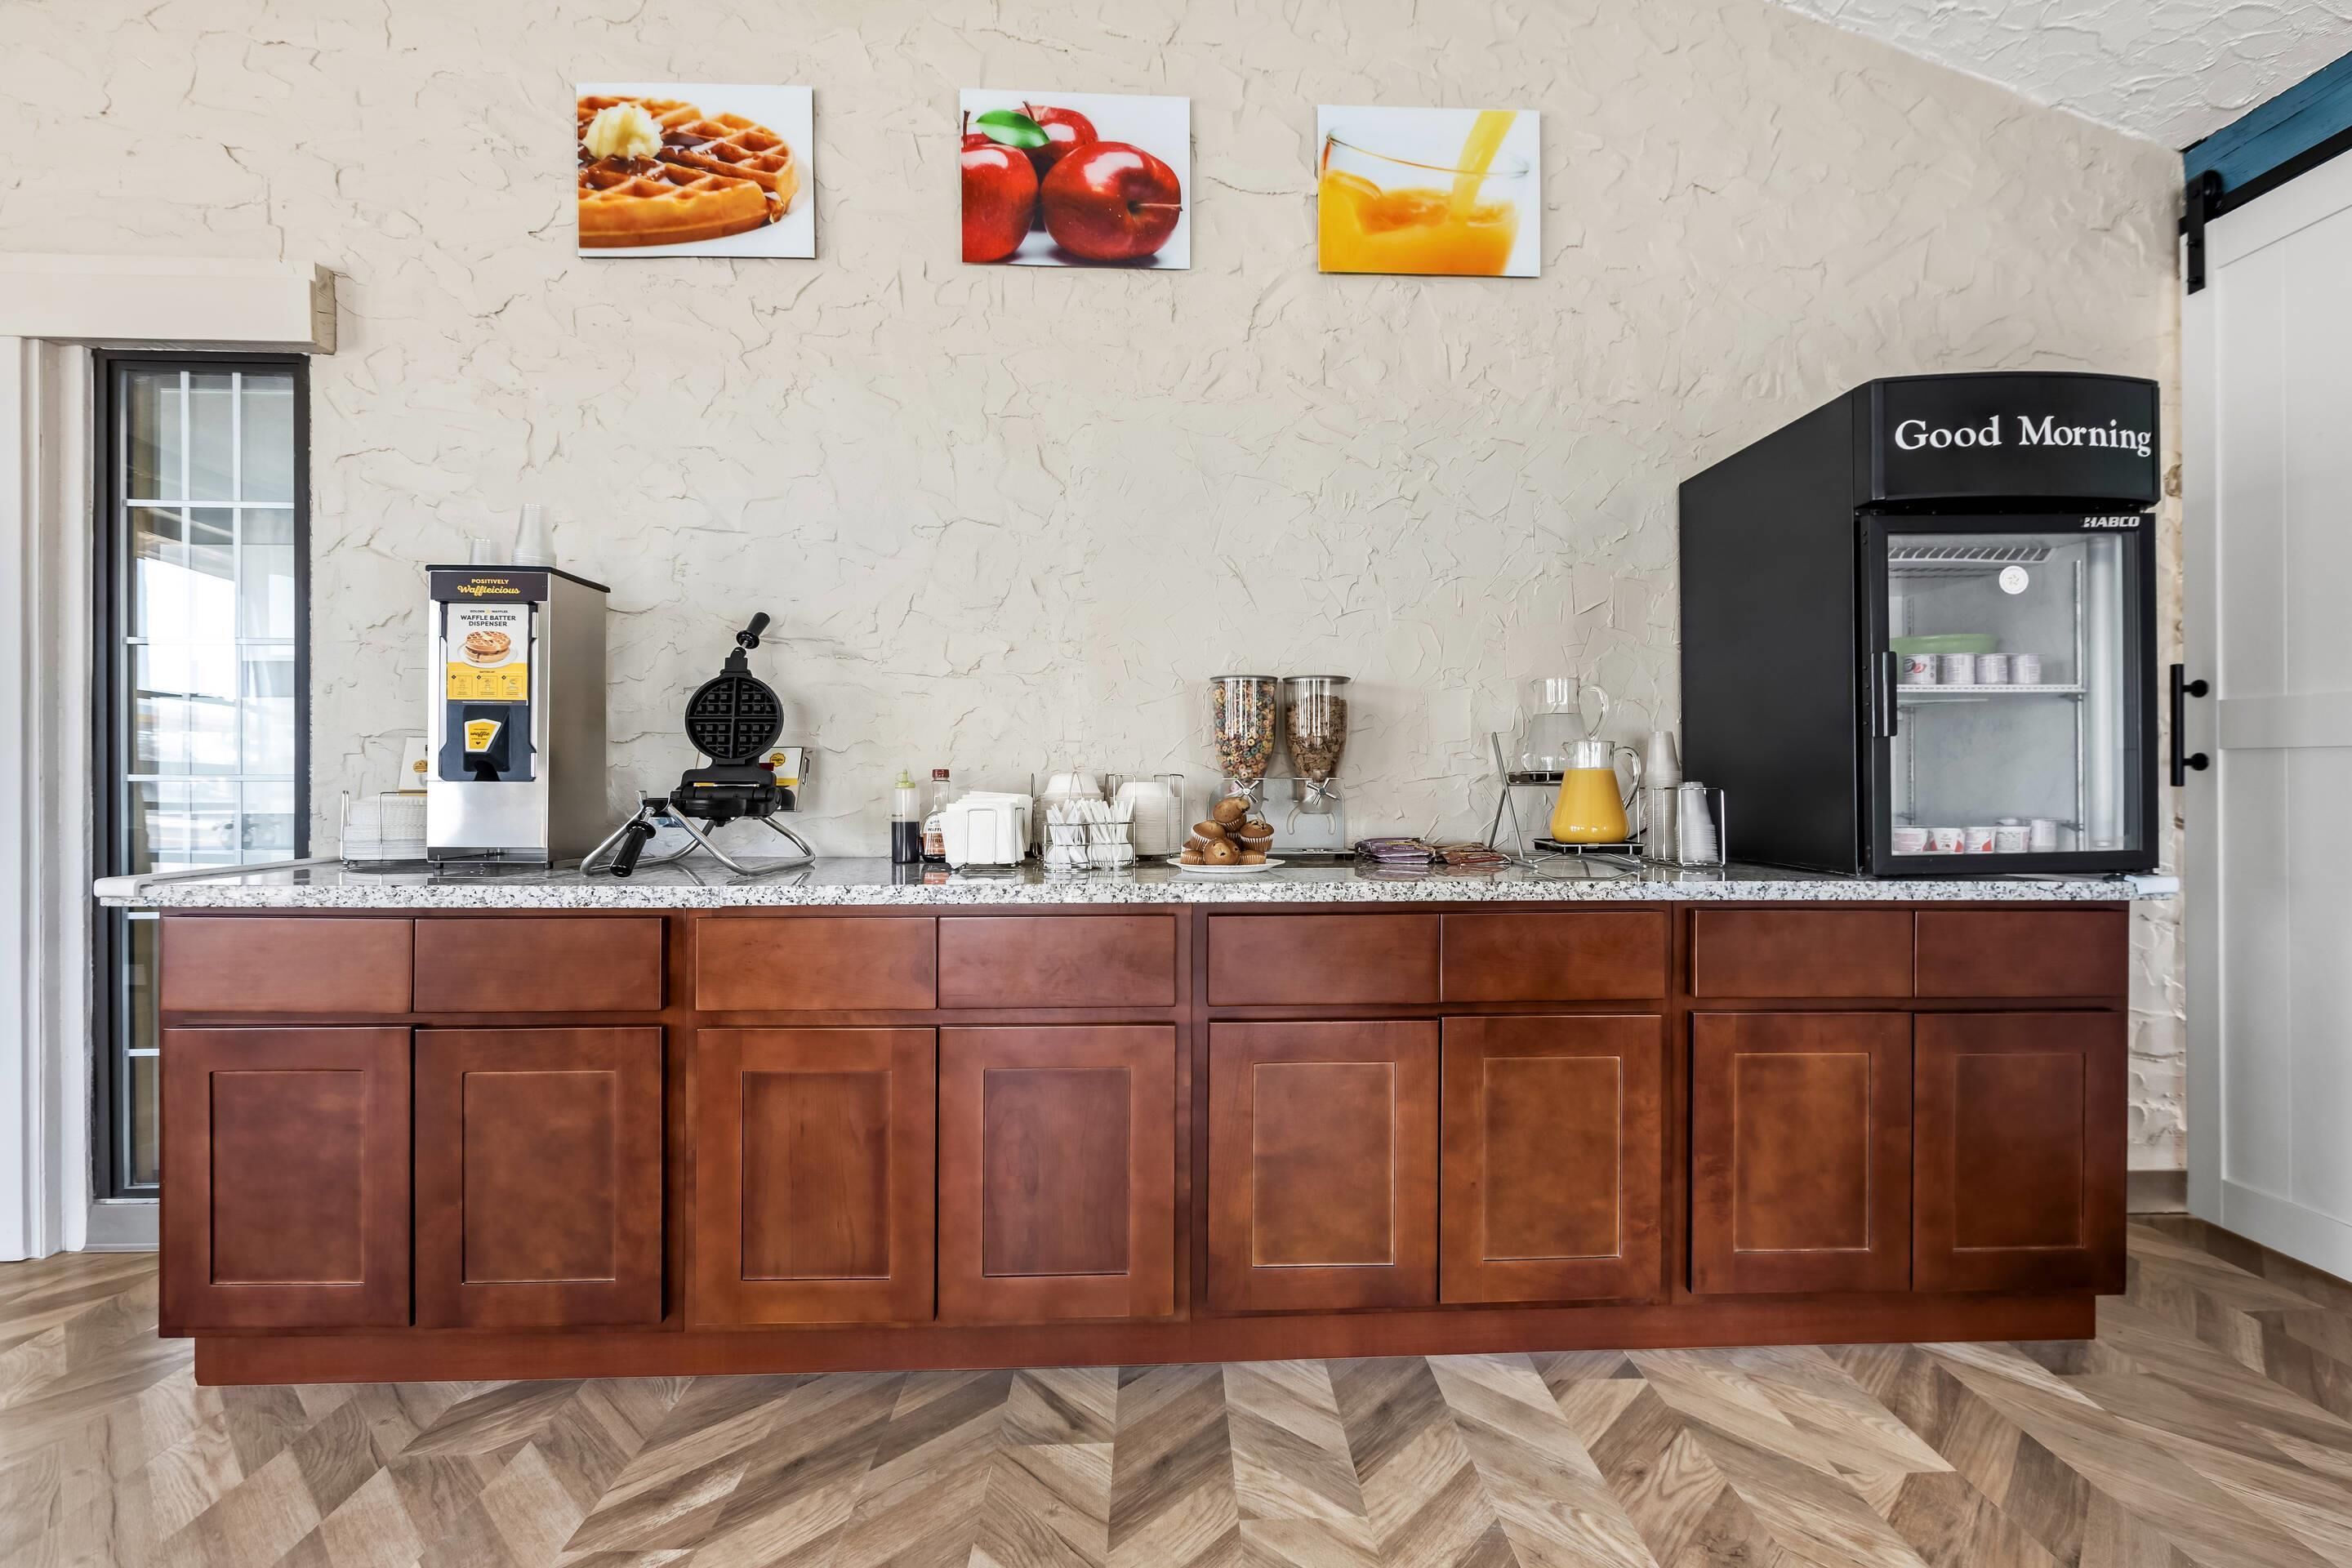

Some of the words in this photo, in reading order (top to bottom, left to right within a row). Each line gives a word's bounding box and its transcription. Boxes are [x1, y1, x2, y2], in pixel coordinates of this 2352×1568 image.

[1895, 415, 2002, 450] Good
[2017, 415, 2152, 457] Morning
[2083, 516, 2140, 528] HABCO
